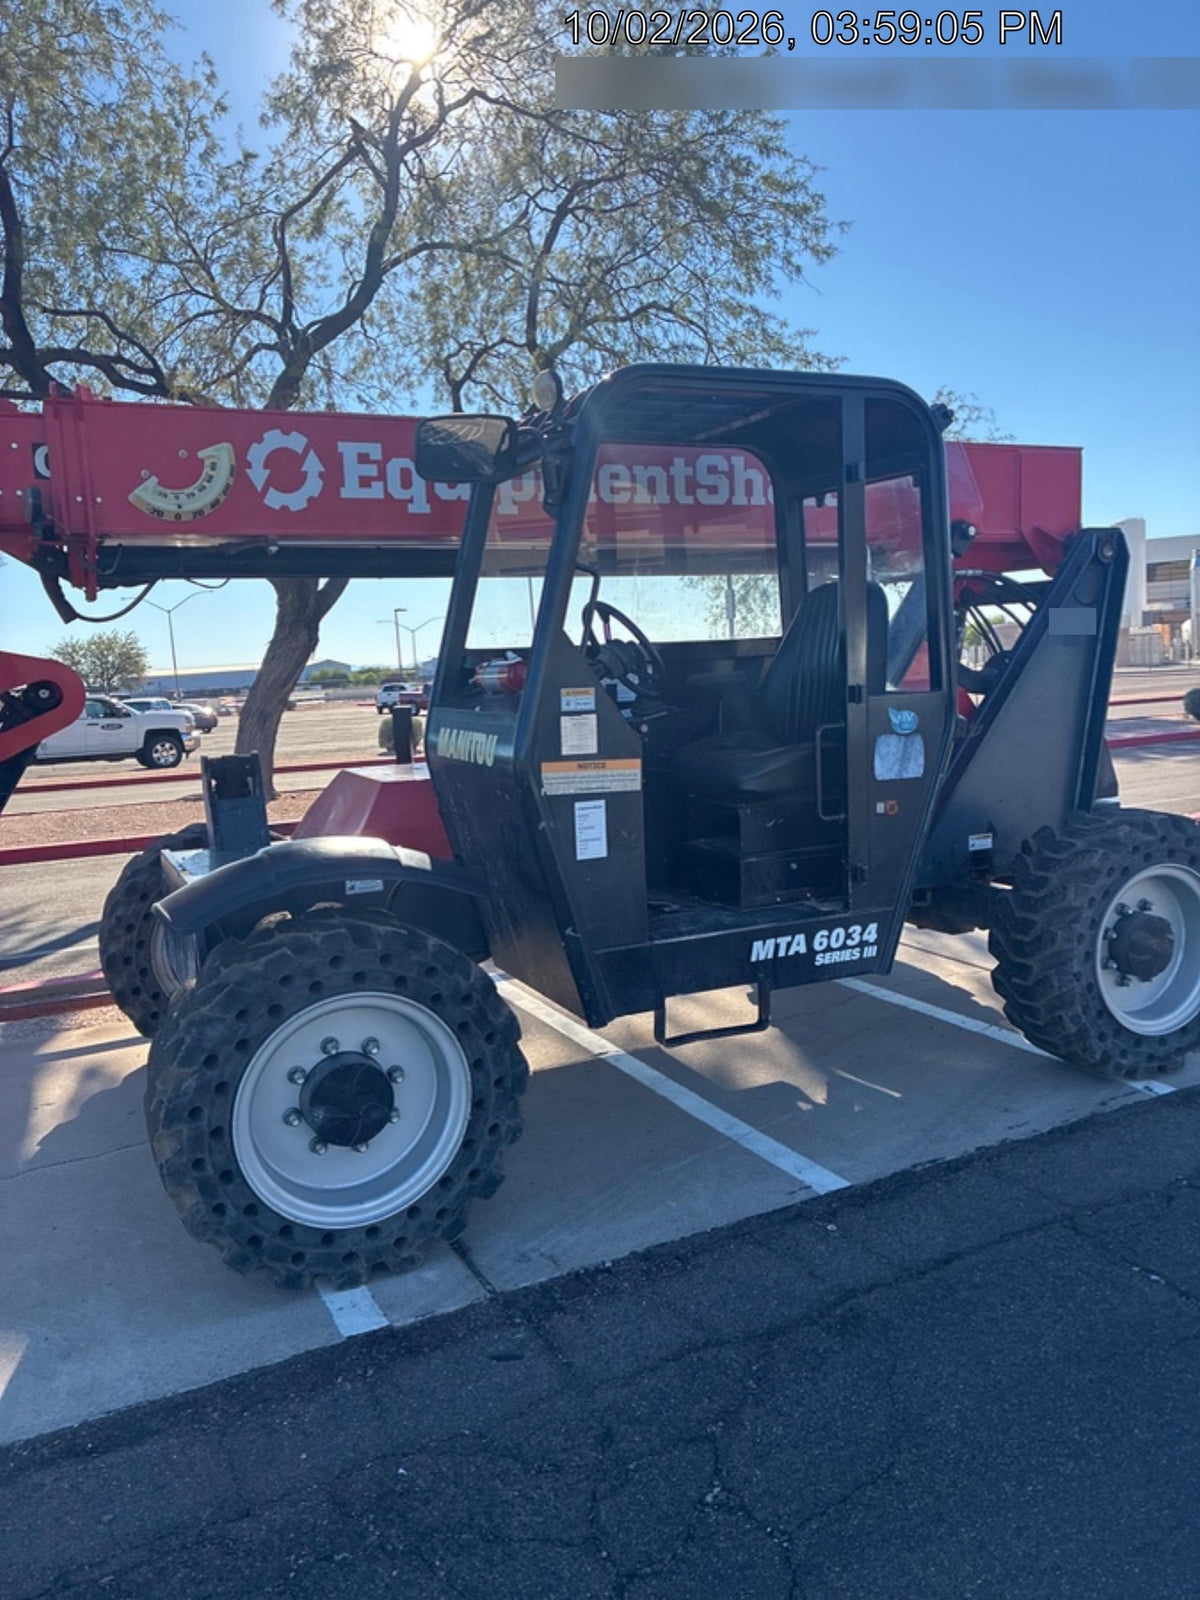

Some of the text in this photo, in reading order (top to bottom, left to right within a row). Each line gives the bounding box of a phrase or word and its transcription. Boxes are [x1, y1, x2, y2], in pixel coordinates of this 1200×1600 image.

[437, 727, 498, 768] MANITOU
[750, 922, 878, 962] MTA 6034
[814, 945, 878, 966] SERIES III
